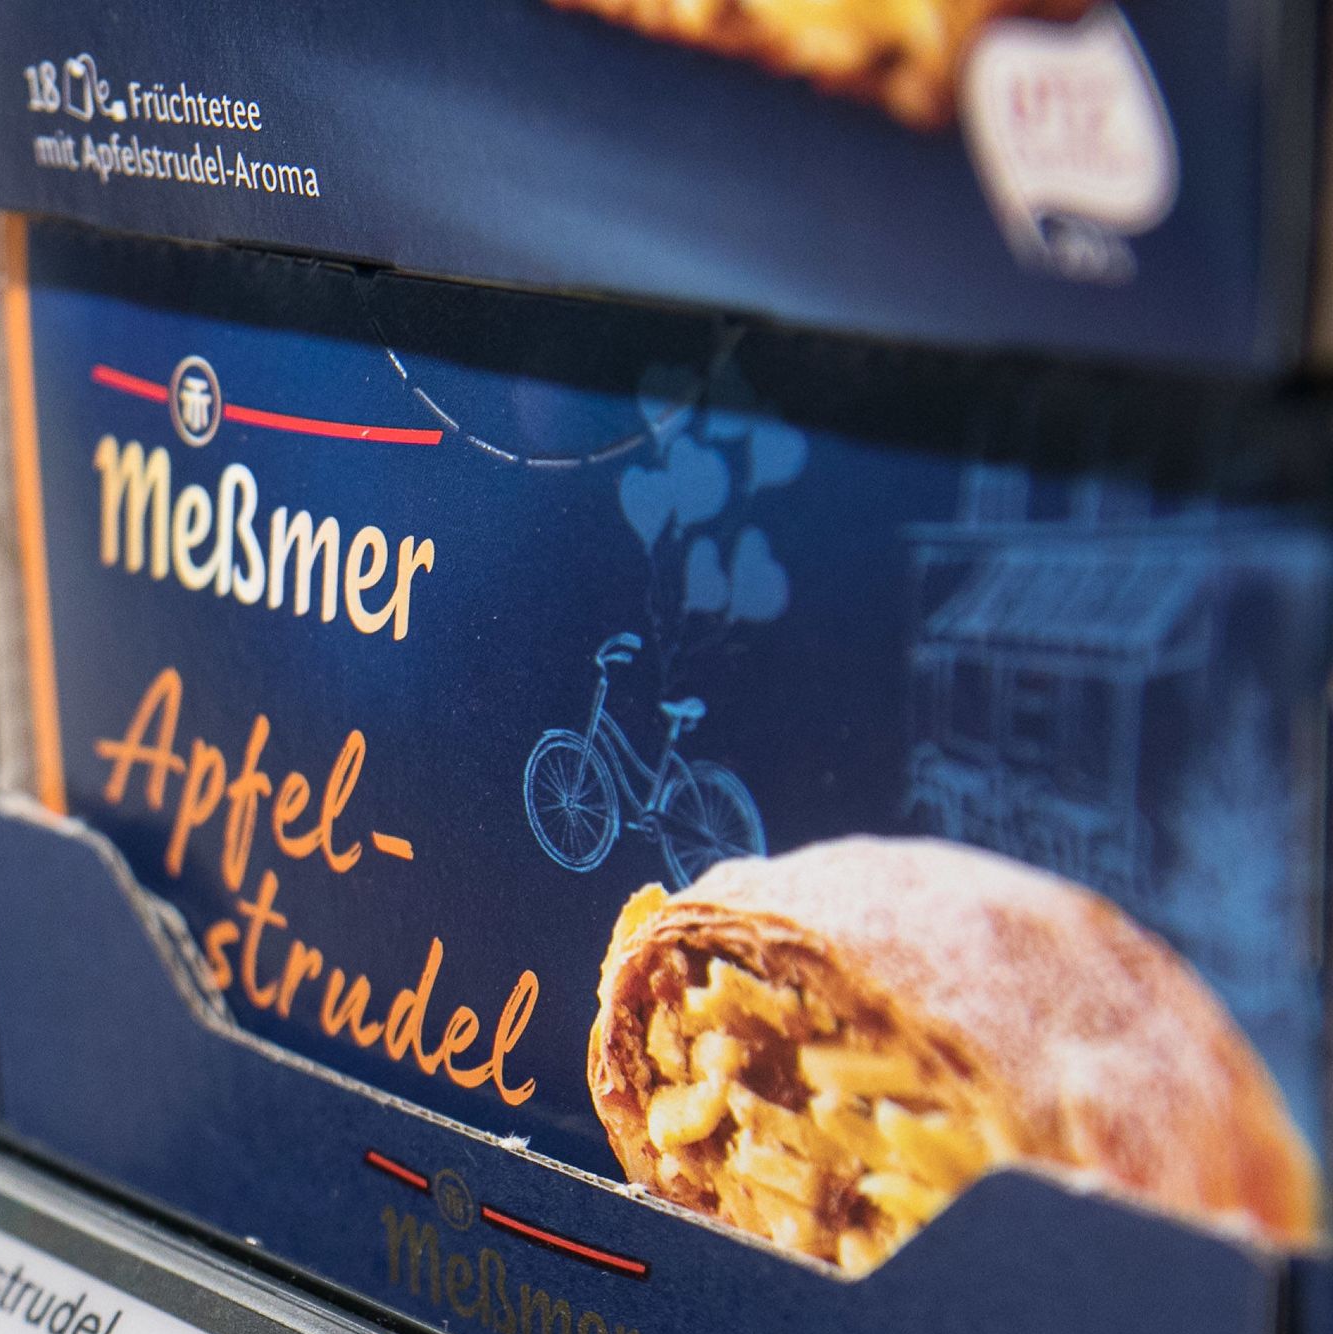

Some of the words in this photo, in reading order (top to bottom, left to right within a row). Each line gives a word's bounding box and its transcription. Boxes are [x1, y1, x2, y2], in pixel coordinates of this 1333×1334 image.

[23, 61, 61, 113] 18
[128, 81, 263, 131] Früchtetee
[34, 130, 79, 172] mit
[81, 131, 321, 198] Apfelstrudel-Aroma
[94, 433, 435, 641] Meßmer
[96, 668, 414, 891] Apfel-
[203, 872, 538, 1105] strudel
